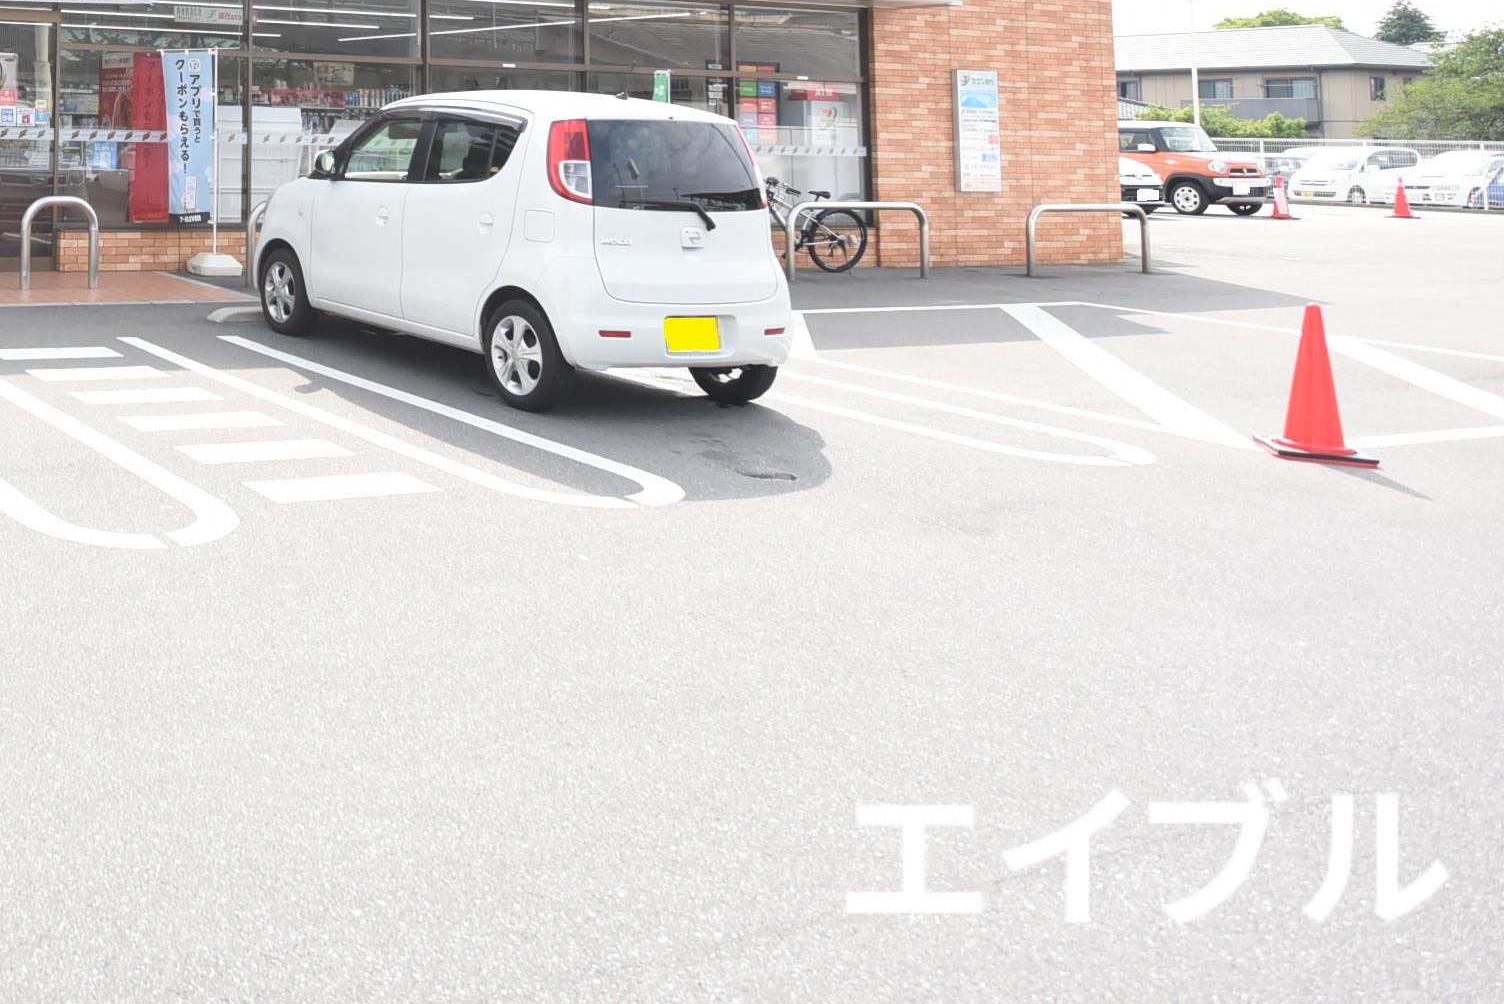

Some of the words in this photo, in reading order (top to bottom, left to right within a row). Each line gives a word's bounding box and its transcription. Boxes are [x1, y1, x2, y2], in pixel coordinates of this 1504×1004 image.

[189, 73, 203, 144] アプリで買うと
